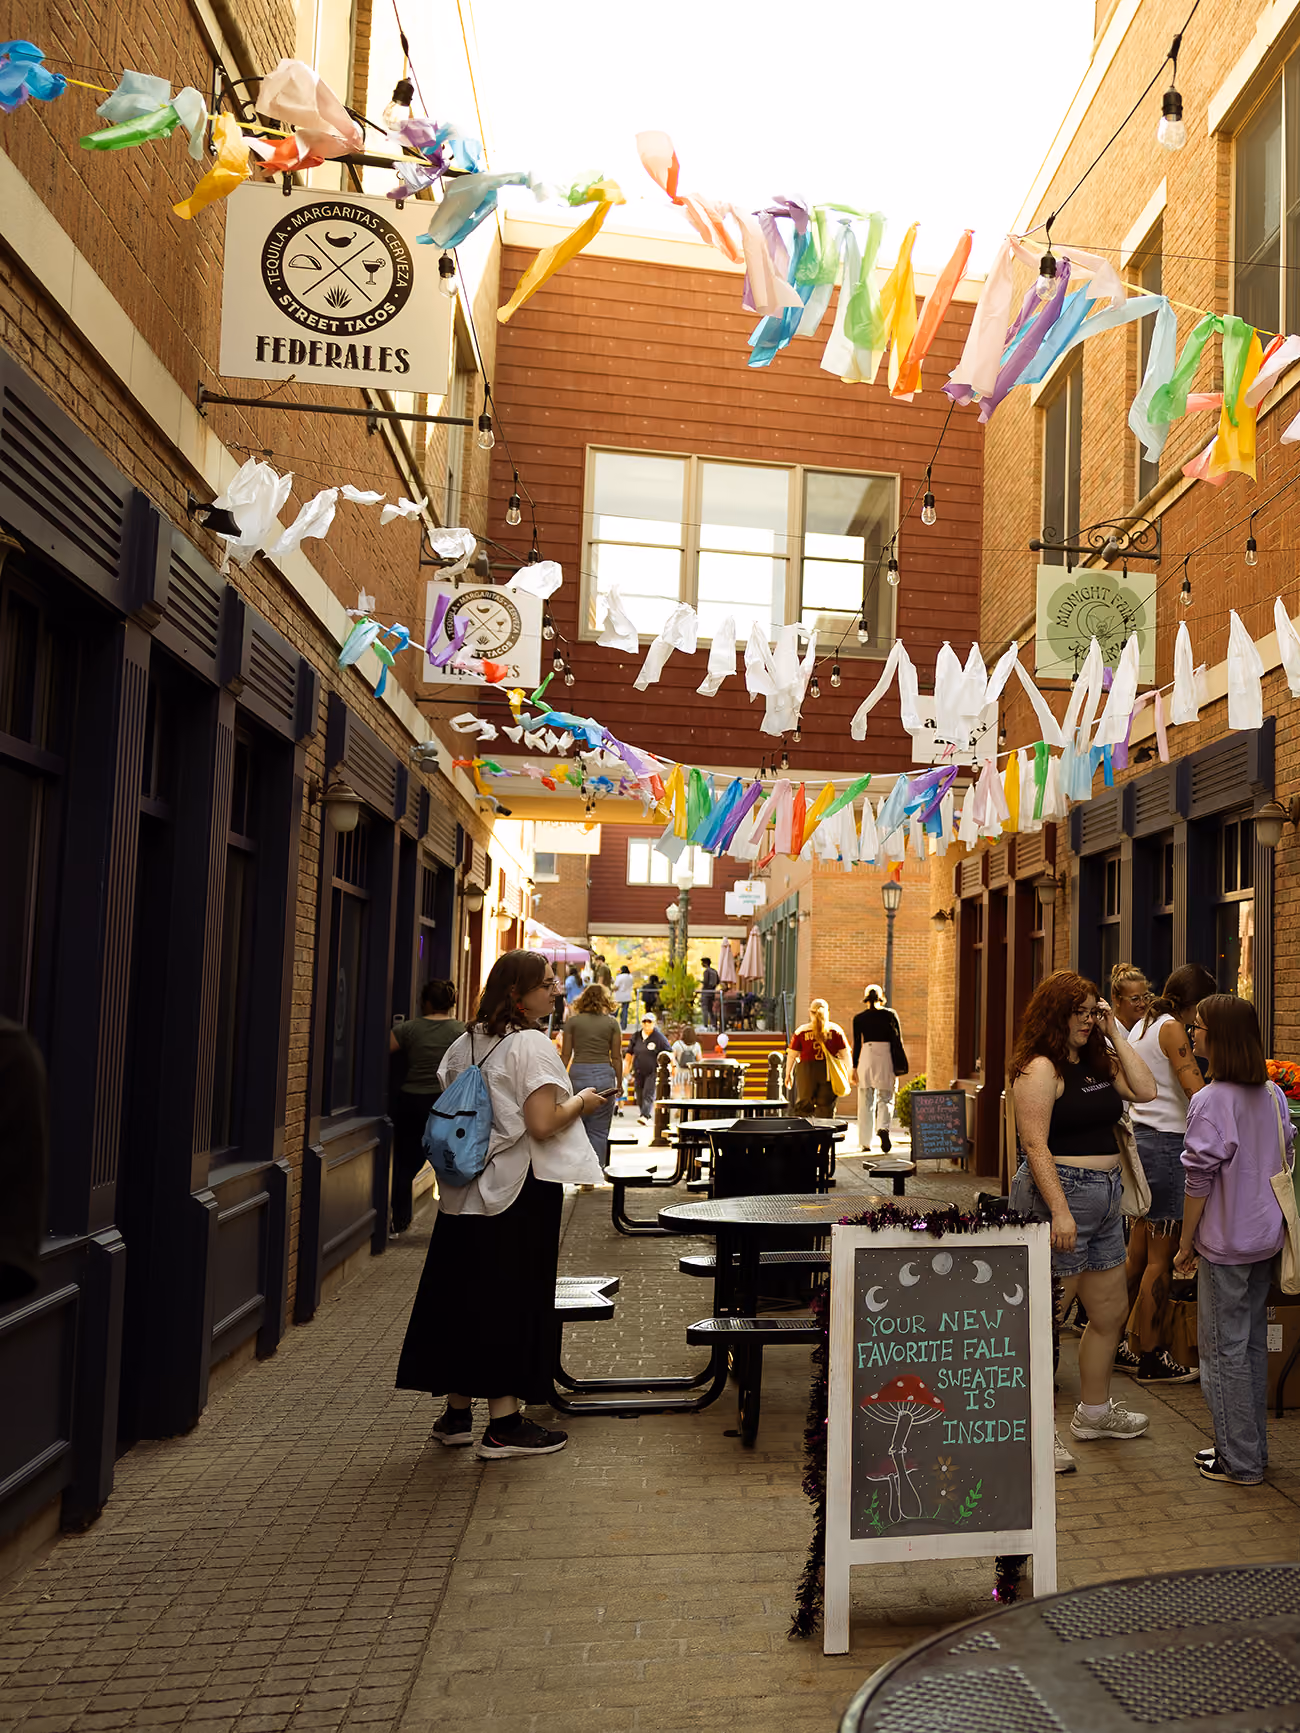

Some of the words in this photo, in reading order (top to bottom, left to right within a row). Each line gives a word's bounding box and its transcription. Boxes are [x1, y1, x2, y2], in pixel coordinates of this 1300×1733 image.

[290, 205, 380, 229] MARGARITAS
[265, 232, 286, 285] TEQUILA
[384, 232, 409, 288] CERVEZA
[278, 294, 340, 332] STREET
[344, 301, 396, 332] TACOS
[255, 334, 411, 375] FEDERALES
[1056, 586, 1111, 628] MIDNIGHT
[486, 640, 514, 658] TACOS
[866, 1315, 927, 1337] YOUR
[939, 1309, 1004, 1332] NEW
[857, 1339, 954, 1369] FAVORITE
[963, 1337, 1016, 1360] FALL
[937, 1366, 1027, 1389] SWEATER
[964, 1388, 996, 1411] IS
[942, 1419, 1027, 1445] INSIDE
